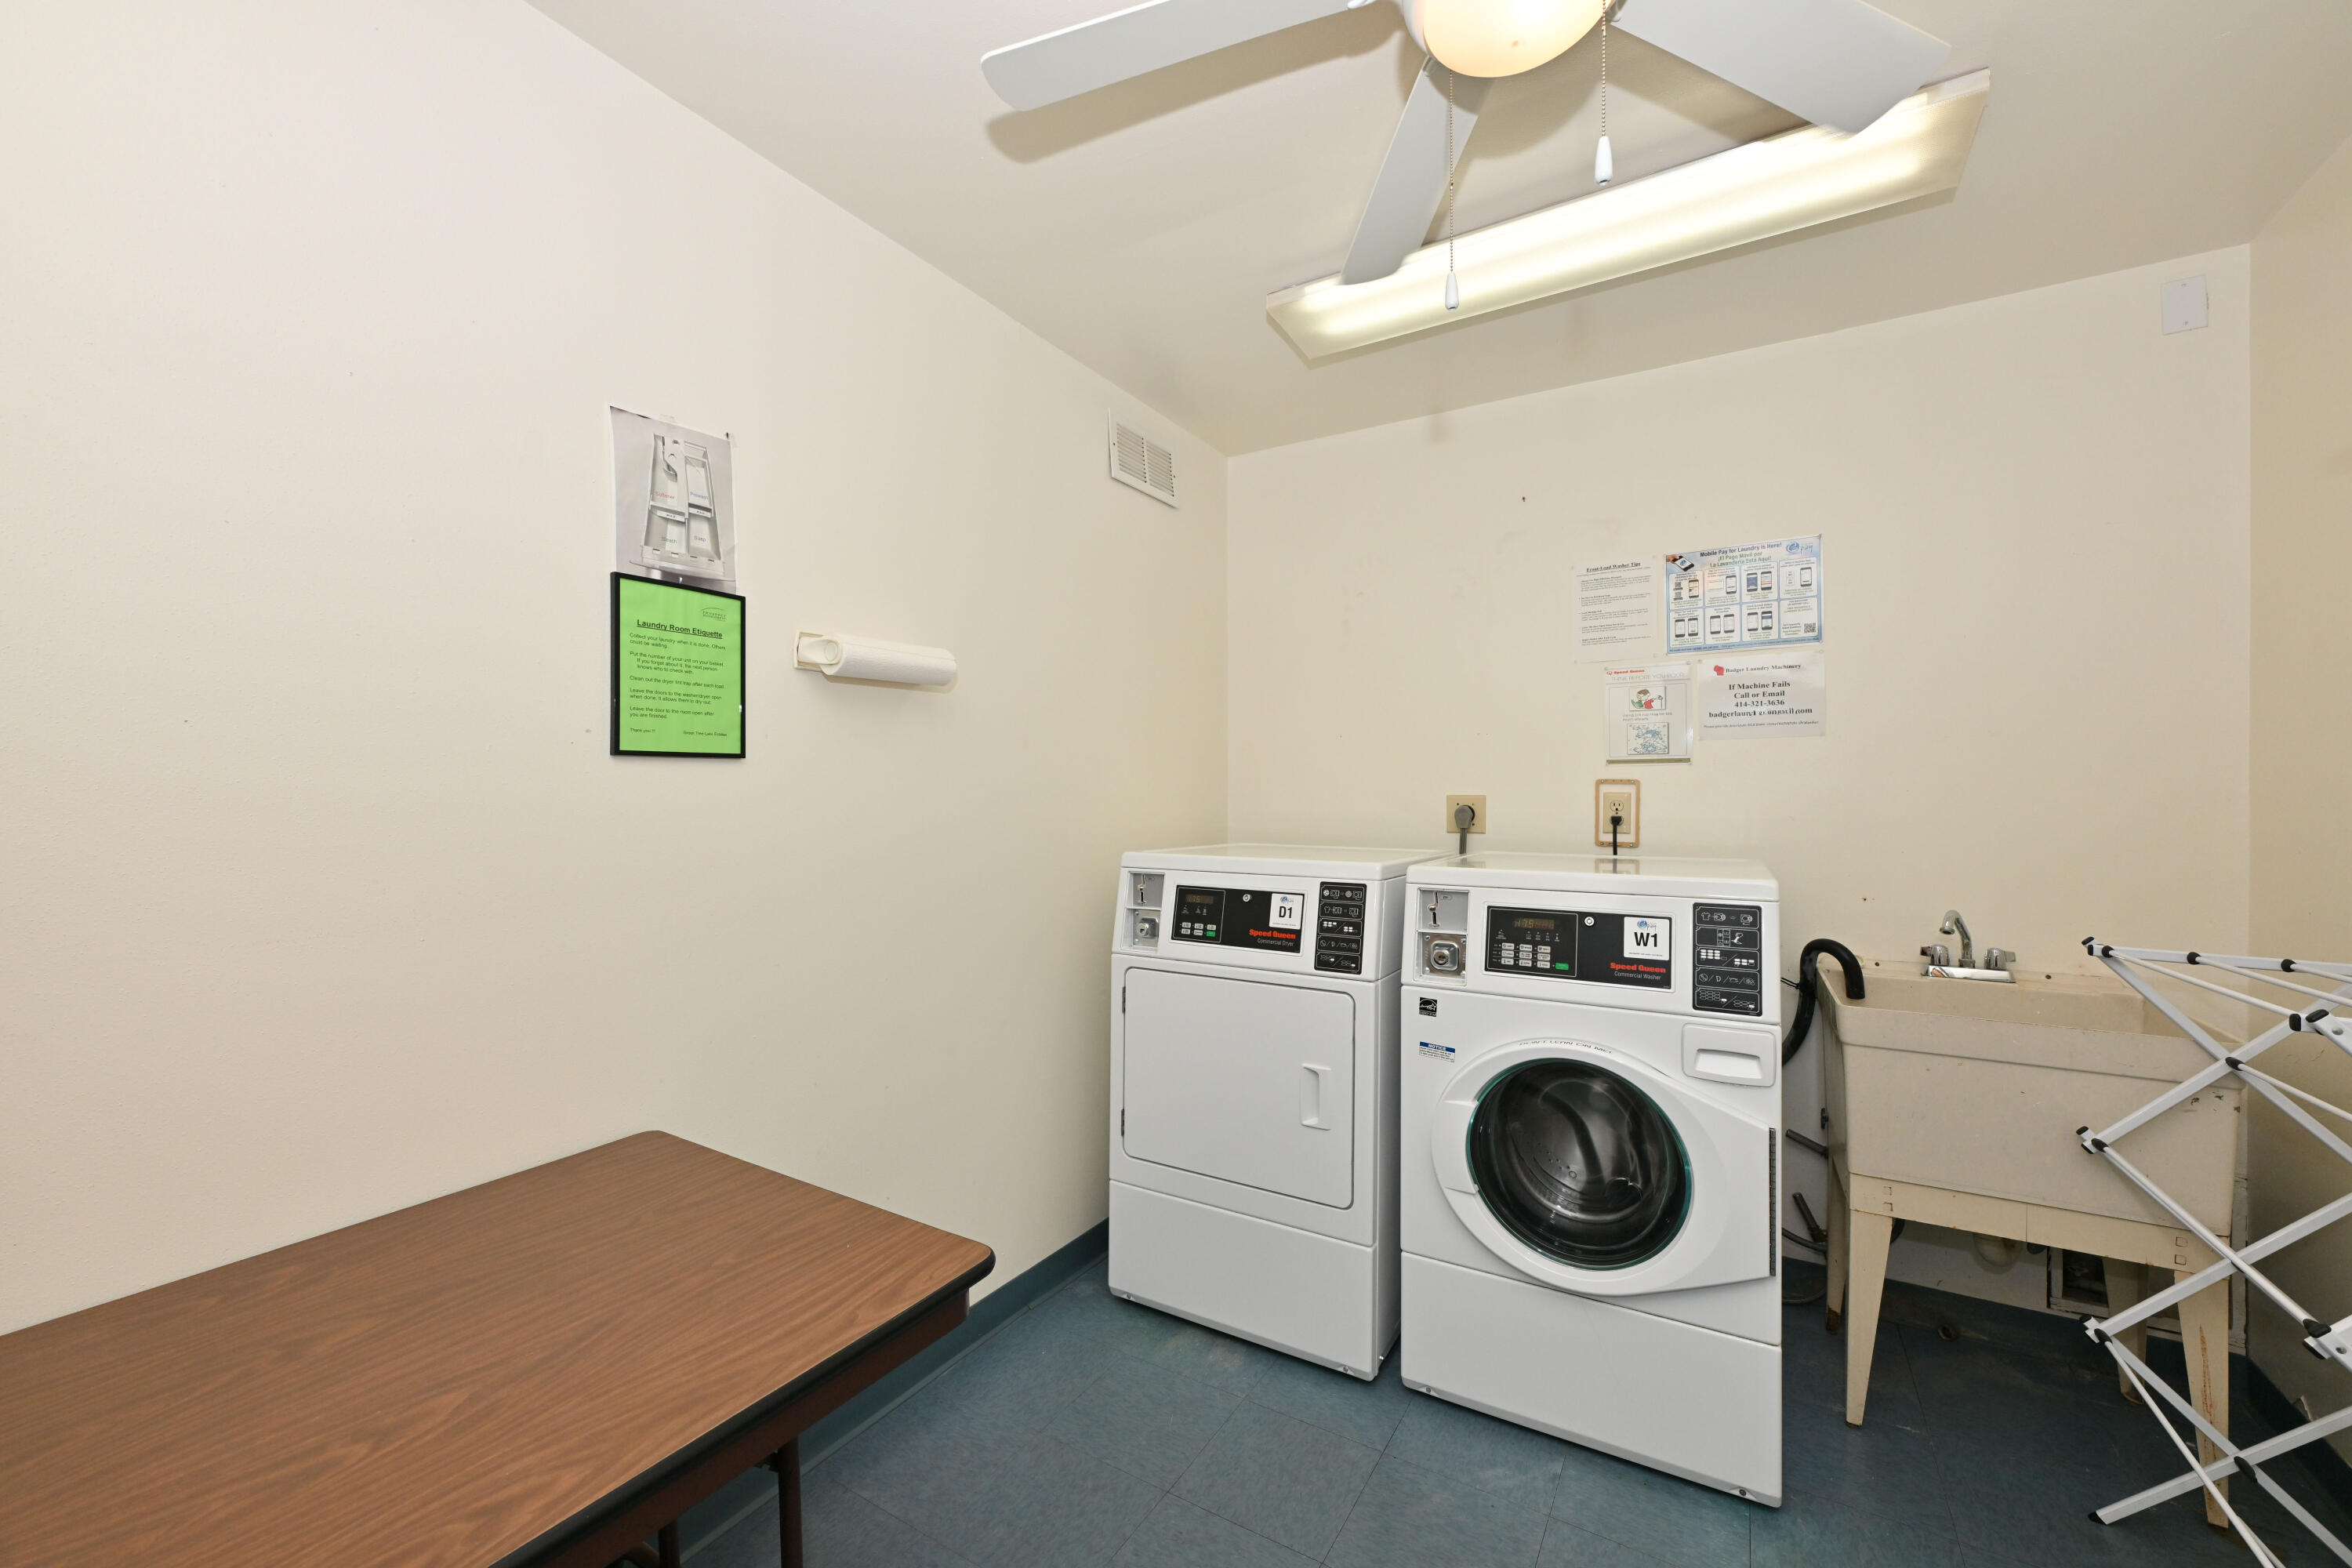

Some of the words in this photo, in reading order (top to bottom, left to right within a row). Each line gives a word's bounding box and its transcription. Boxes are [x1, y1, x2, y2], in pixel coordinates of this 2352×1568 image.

[637, 619, 667, 630] Laundry
[669, 624, 690, 633] Room
[692, 628, 722, 638] Etiquette
[1279, 906, 1292, 918] D1
[1249, 929, 1272, 937] Speed
[1273, 931, 1296, 939] Queen
[1634, 932, 1657, 947] W1
[1610, 962, 1637, 970] Speed
[1638, 964, 1666, 973] Queen
